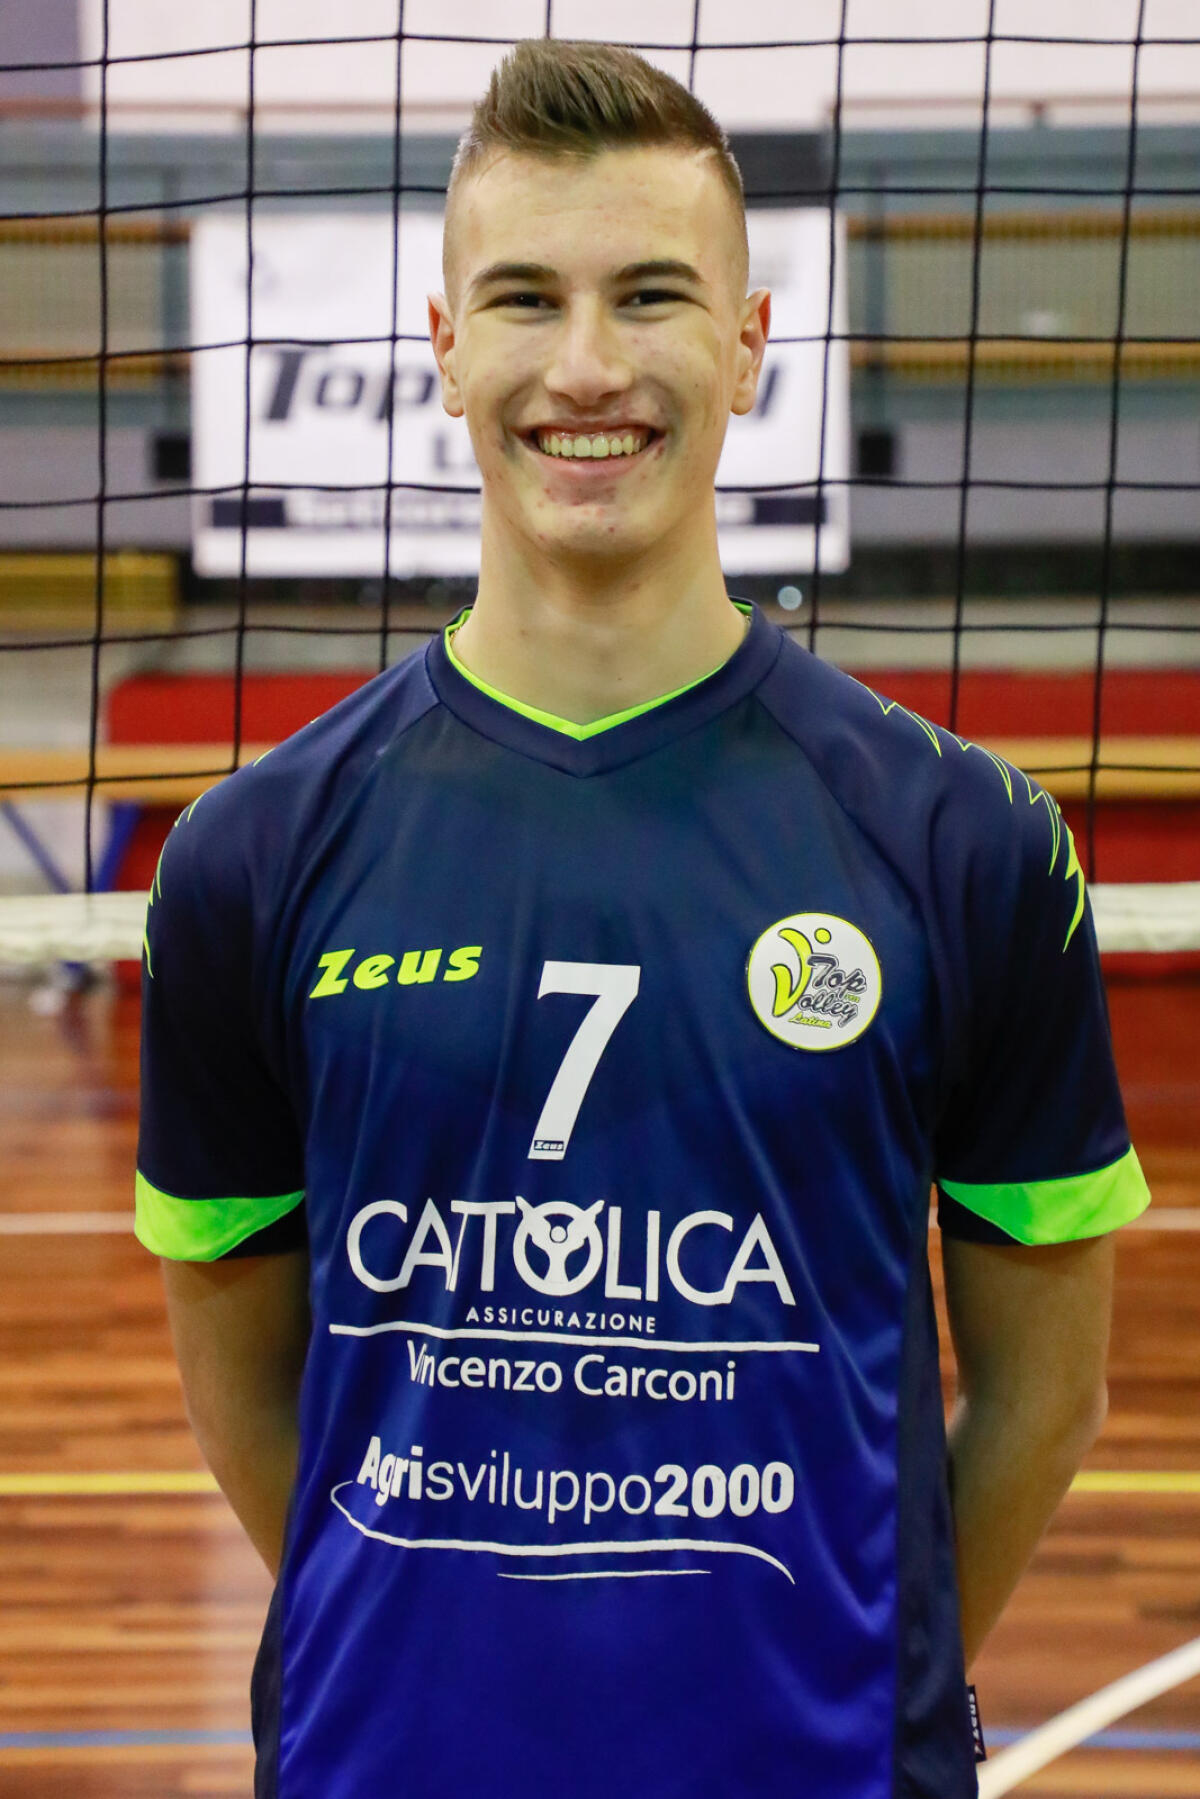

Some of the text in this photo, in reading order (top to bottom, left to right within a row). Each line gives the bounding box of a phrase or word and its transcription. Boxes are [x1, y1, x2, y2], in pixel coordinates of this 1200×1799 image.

[309, 945, 483, 999] Zeus
[807, 953, 867, 998] Top
[527, 960, 641, 1160] 7
[346, 1195, 796, 1306] CATTOLICA
[466, 1306, 657, 1334] ASSICURAZIONE
[574, 1354, 736, 1401] Carconi
[357, 1436, 795, 1525] Agrisviluppo2000
